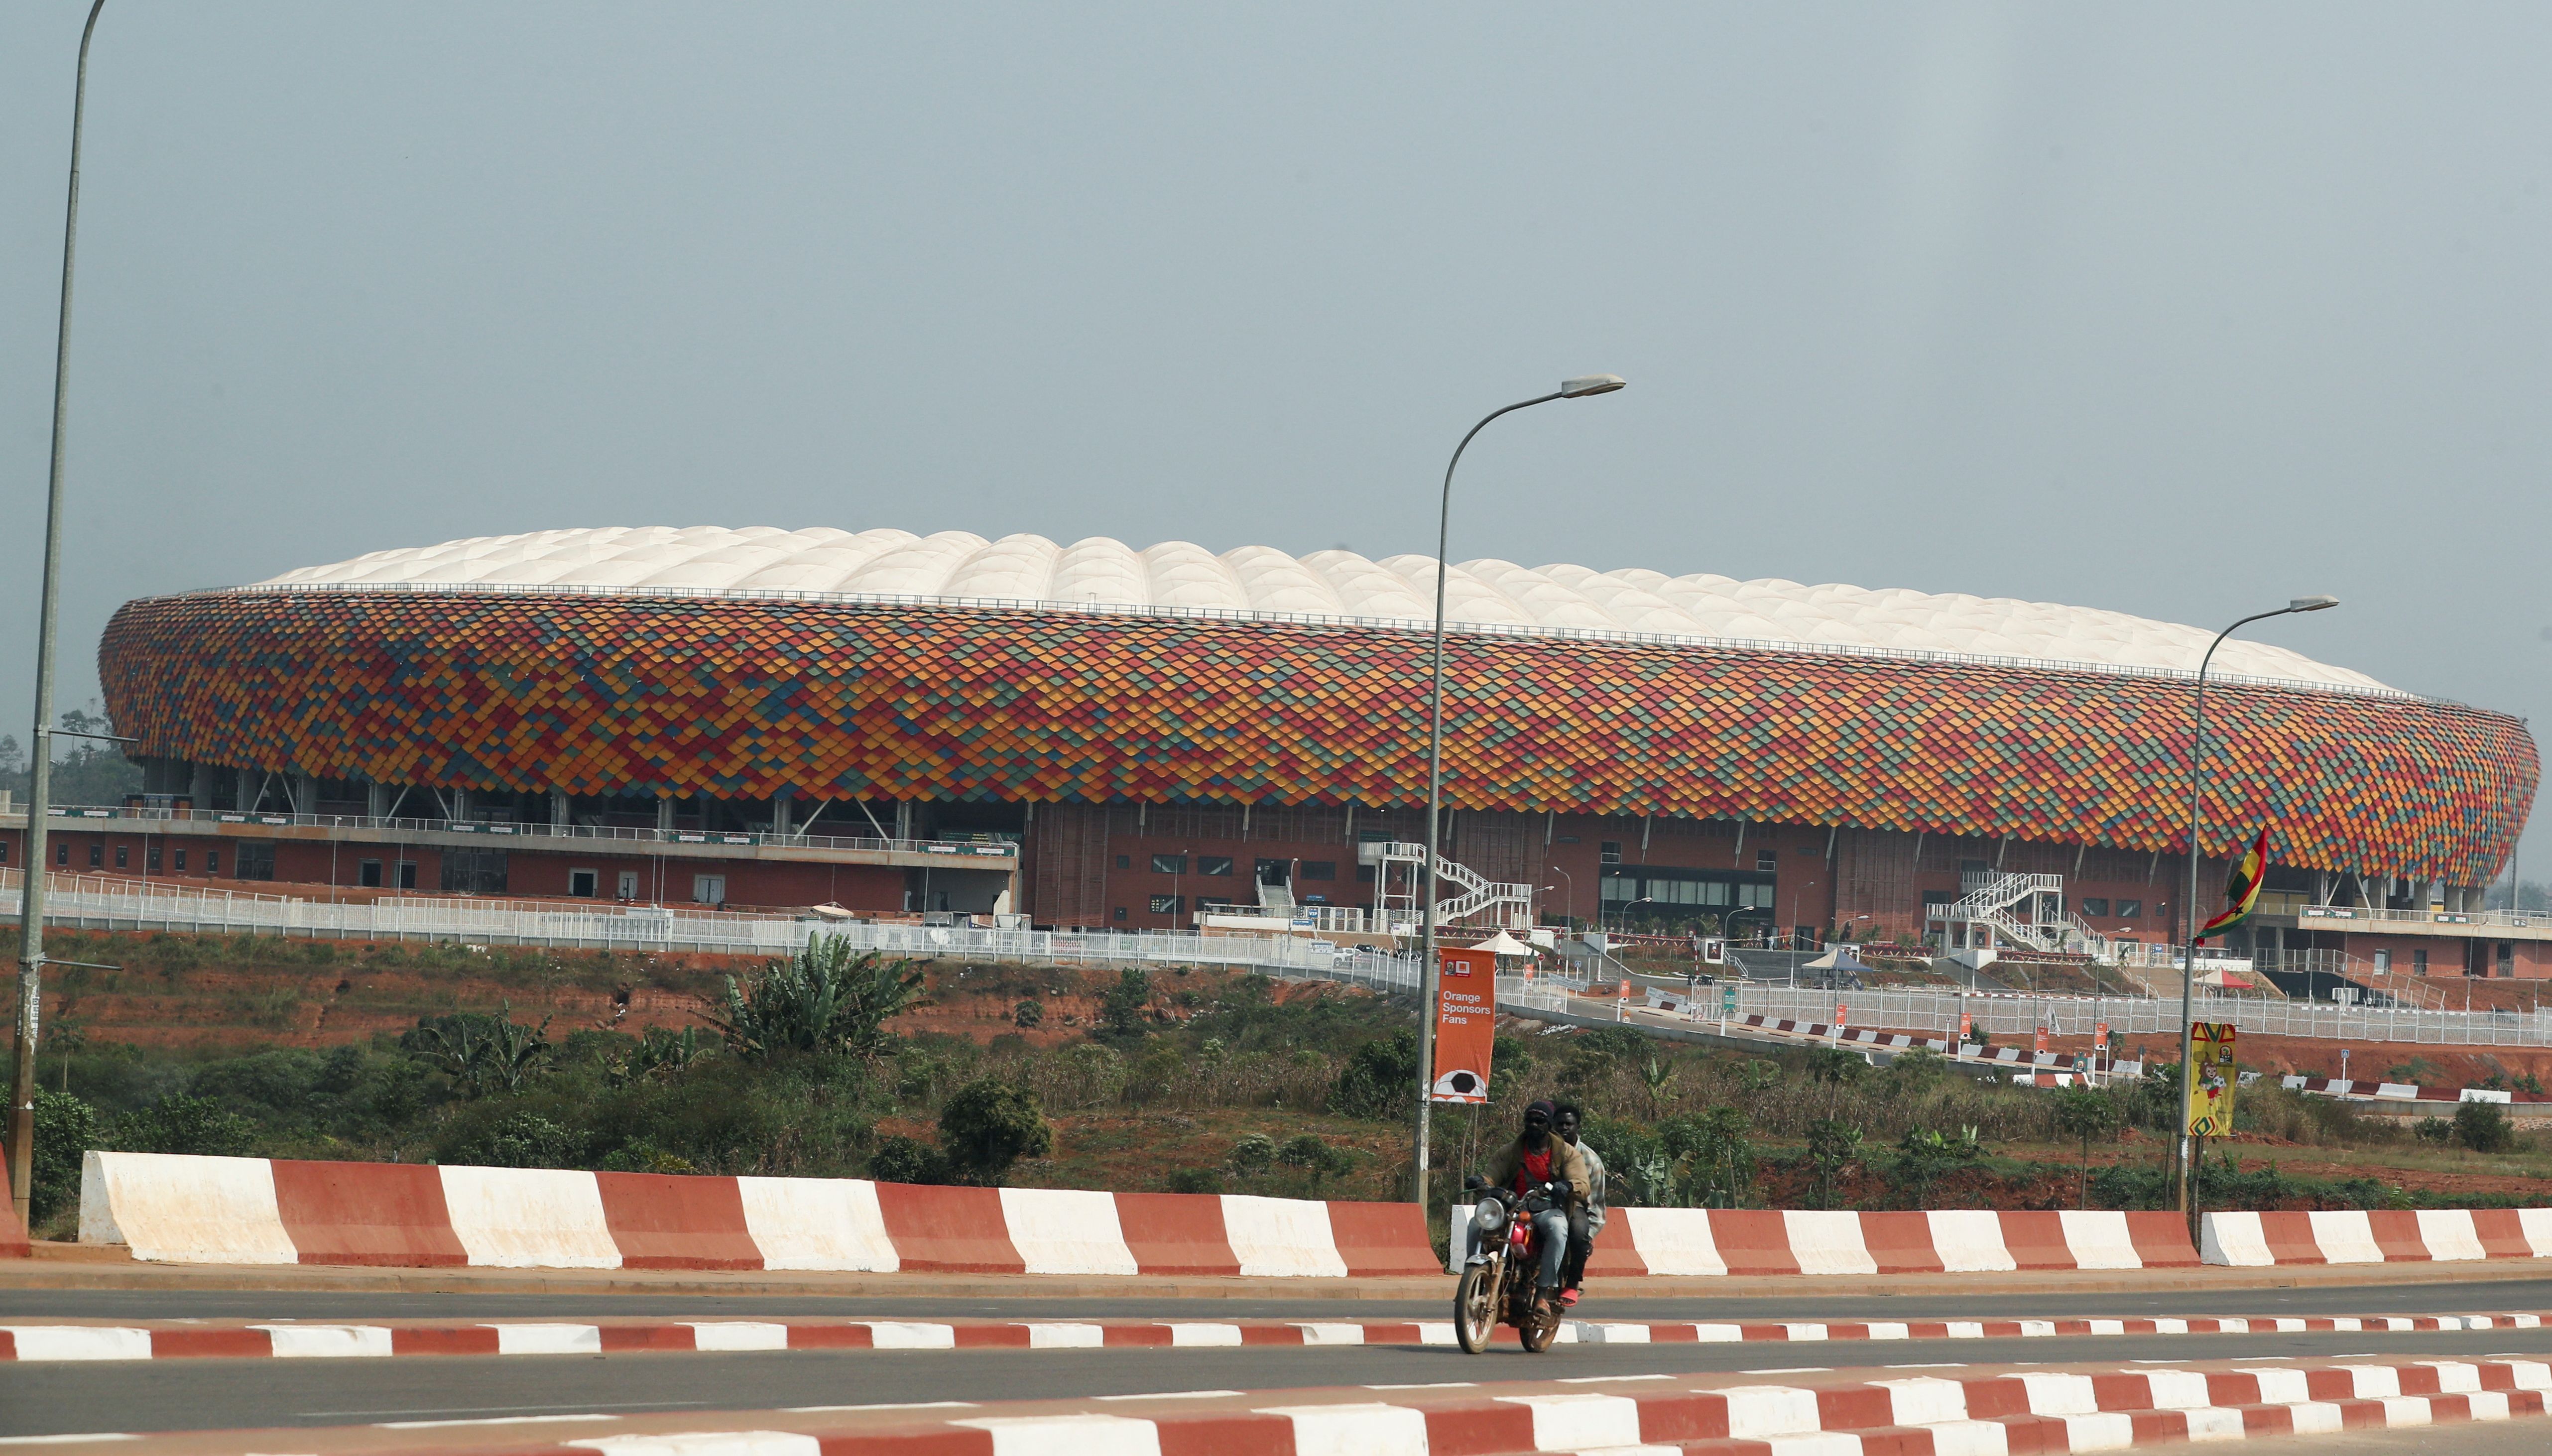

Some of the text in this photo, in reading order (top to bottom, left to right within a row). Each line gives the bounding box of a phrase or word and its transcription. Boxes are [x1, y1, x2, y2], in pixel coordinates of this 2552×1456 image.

[1443, 990, 1480, 1004] Orange
[1443, 1002, 1490, 1014] Sponsors
[1442, 1014, 1467, 1024] Fans
